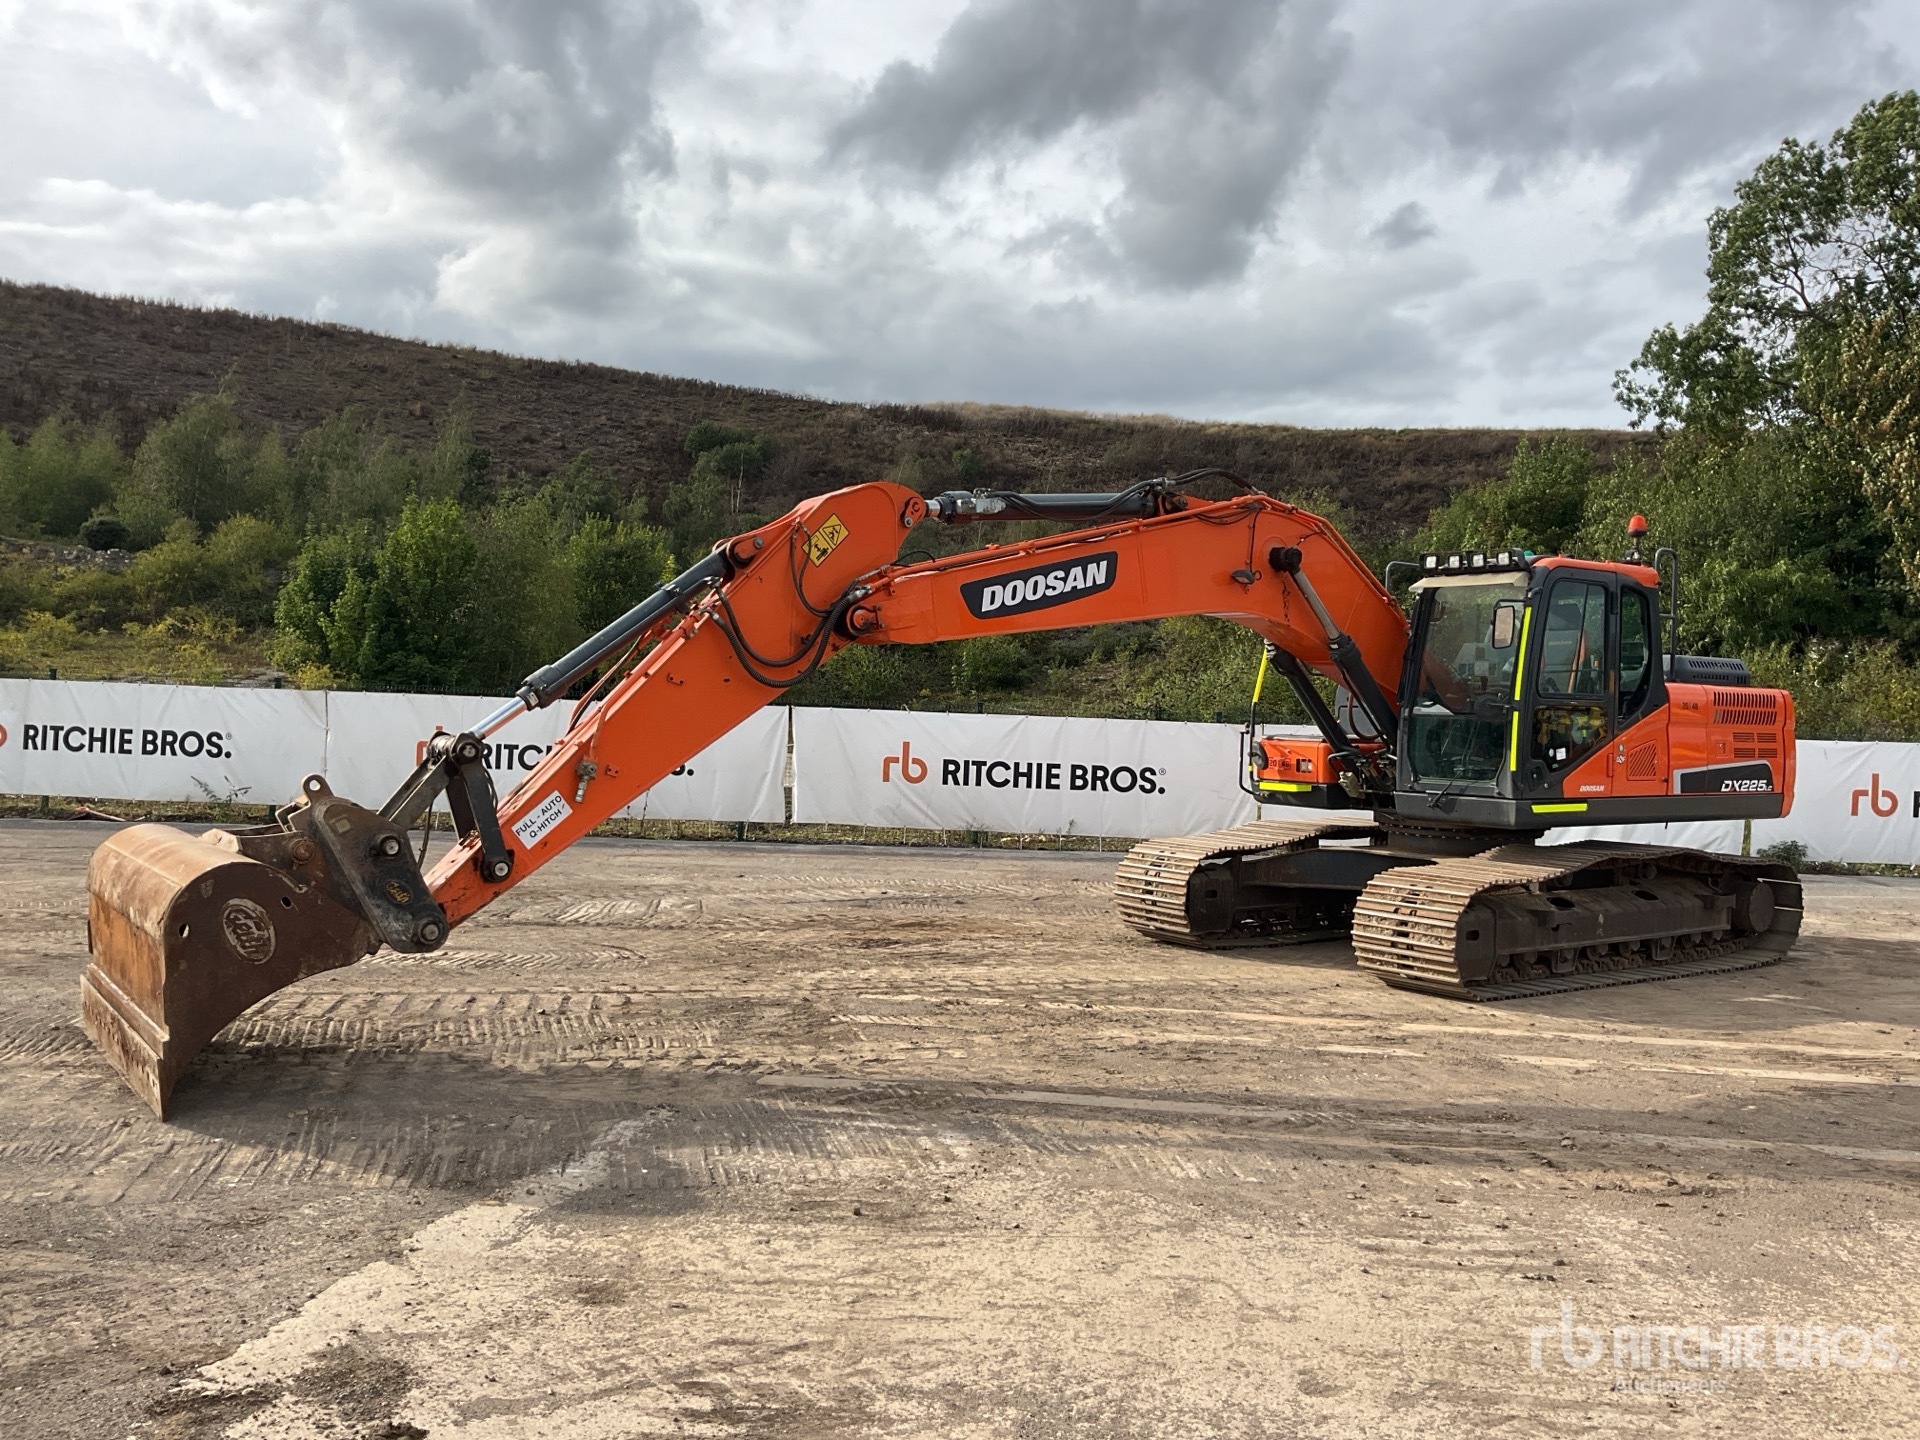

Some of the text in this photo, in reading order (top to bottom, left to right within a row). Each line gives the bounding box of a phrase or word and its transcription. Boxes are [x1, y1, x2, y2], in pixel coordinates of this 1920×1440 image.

[981, 560, 1108, 613] DOOSAN
[22, 724, 133, 755] RITCHIE
[882, 741, 928, 784] rb
[942, 758, 1061, 790] RITCHIE
[515, 818, 537, 837] FULL
[541, 795, 562, 815] AUTO
[1850, 773, 1898, 817] rb
[529, 808, 563, 838] Q-HITCH
